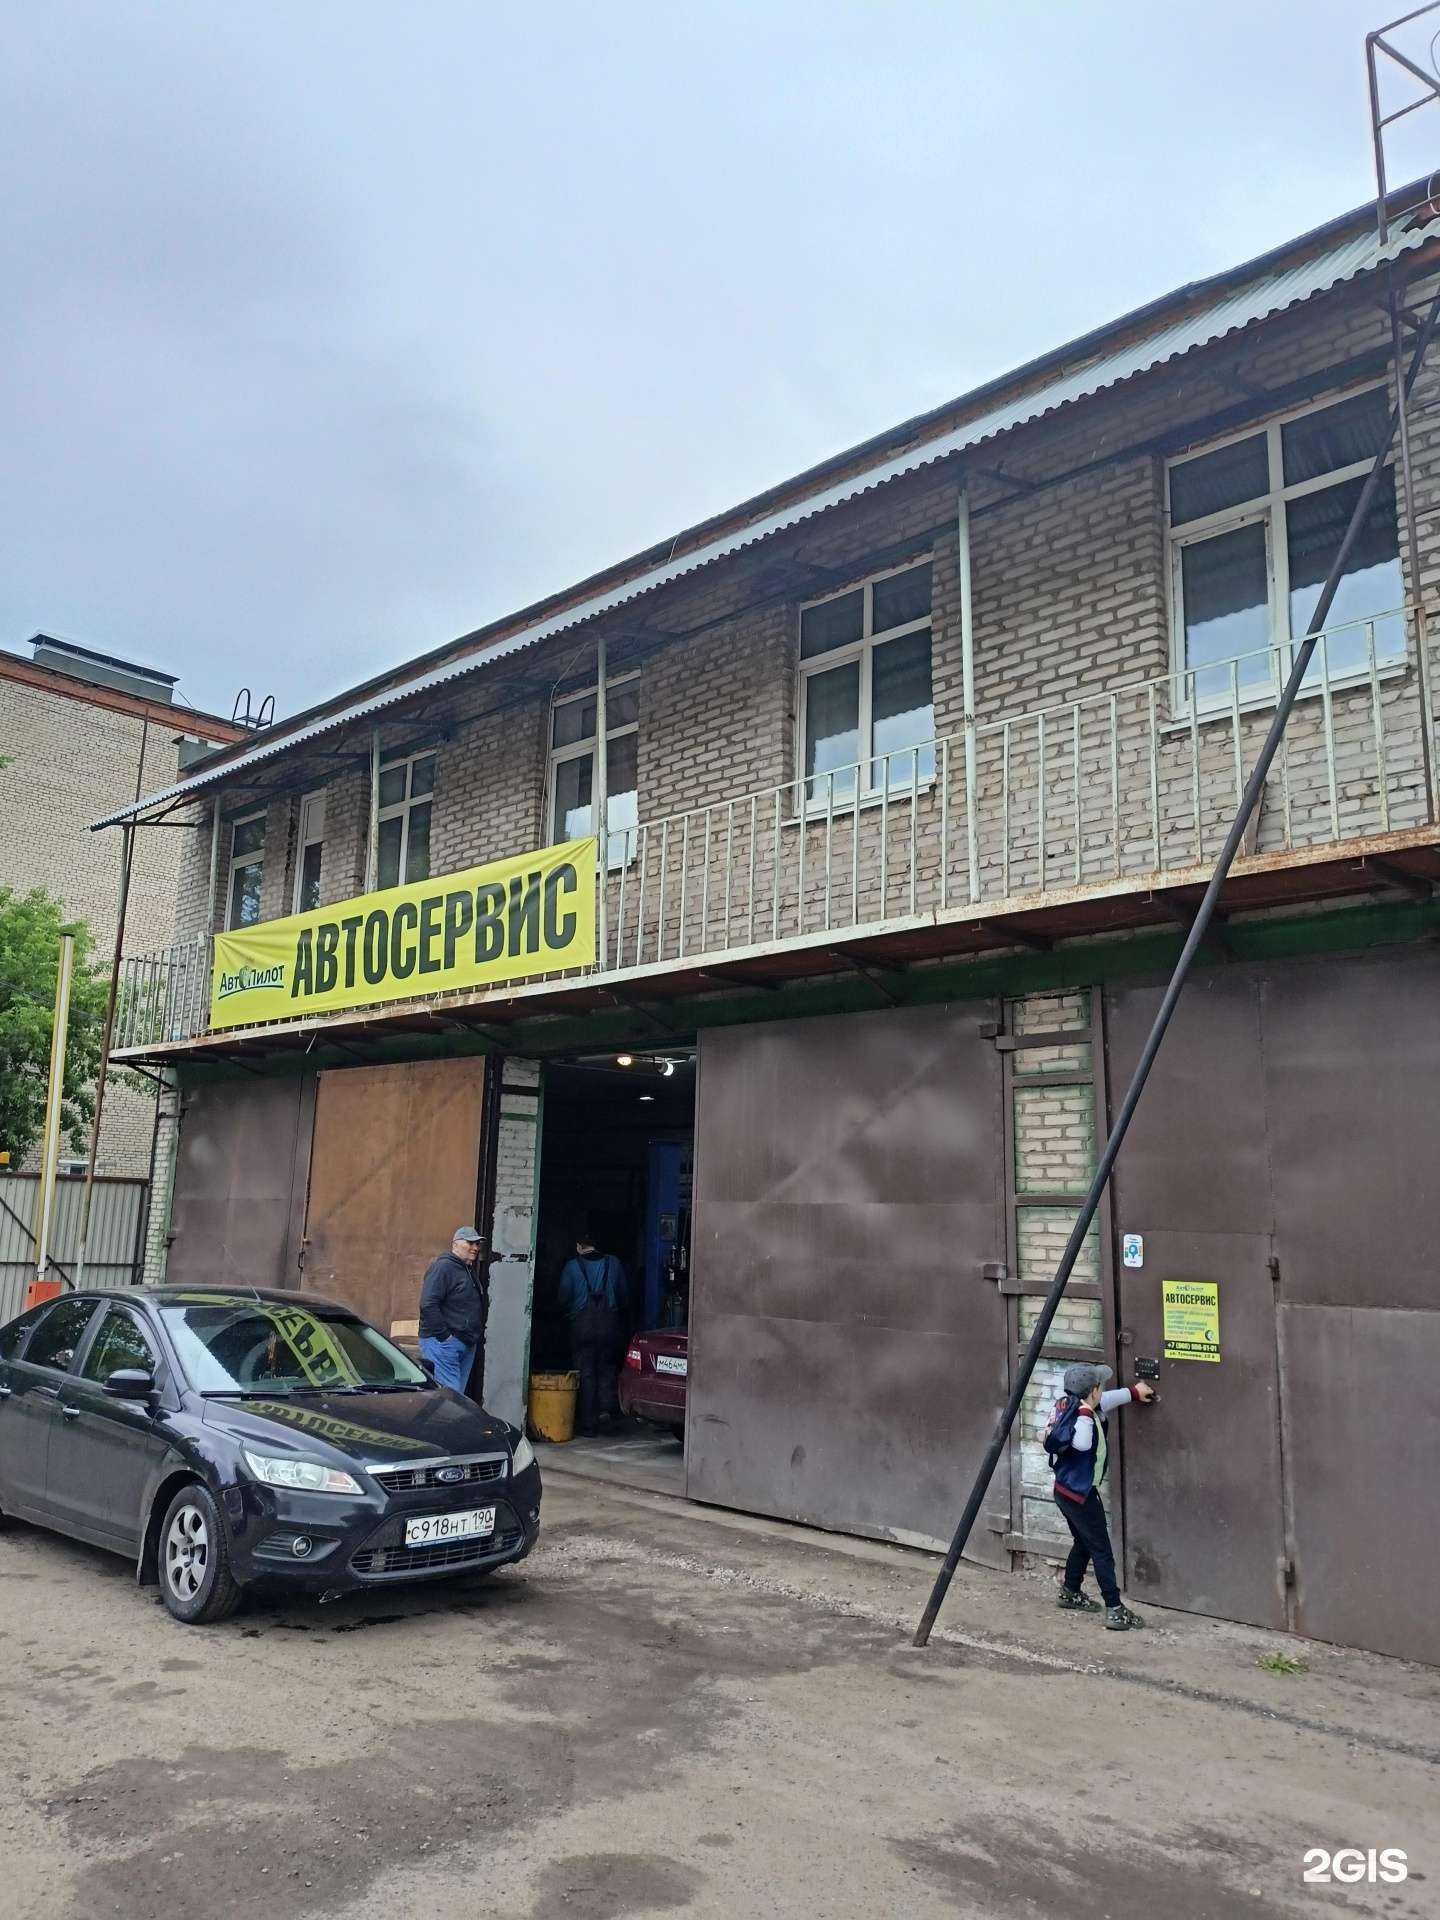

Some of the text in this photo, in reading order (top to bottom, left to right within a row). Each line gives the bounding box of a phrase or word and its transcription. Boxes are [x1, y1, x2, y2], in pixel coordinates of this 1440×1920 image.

[290, 862, 577, 998] АВТОСЕРВИС
[1165, 1293, 1216, 1306] АВТОСЕРВИС
[472, 1509, 492, 1525] 190
